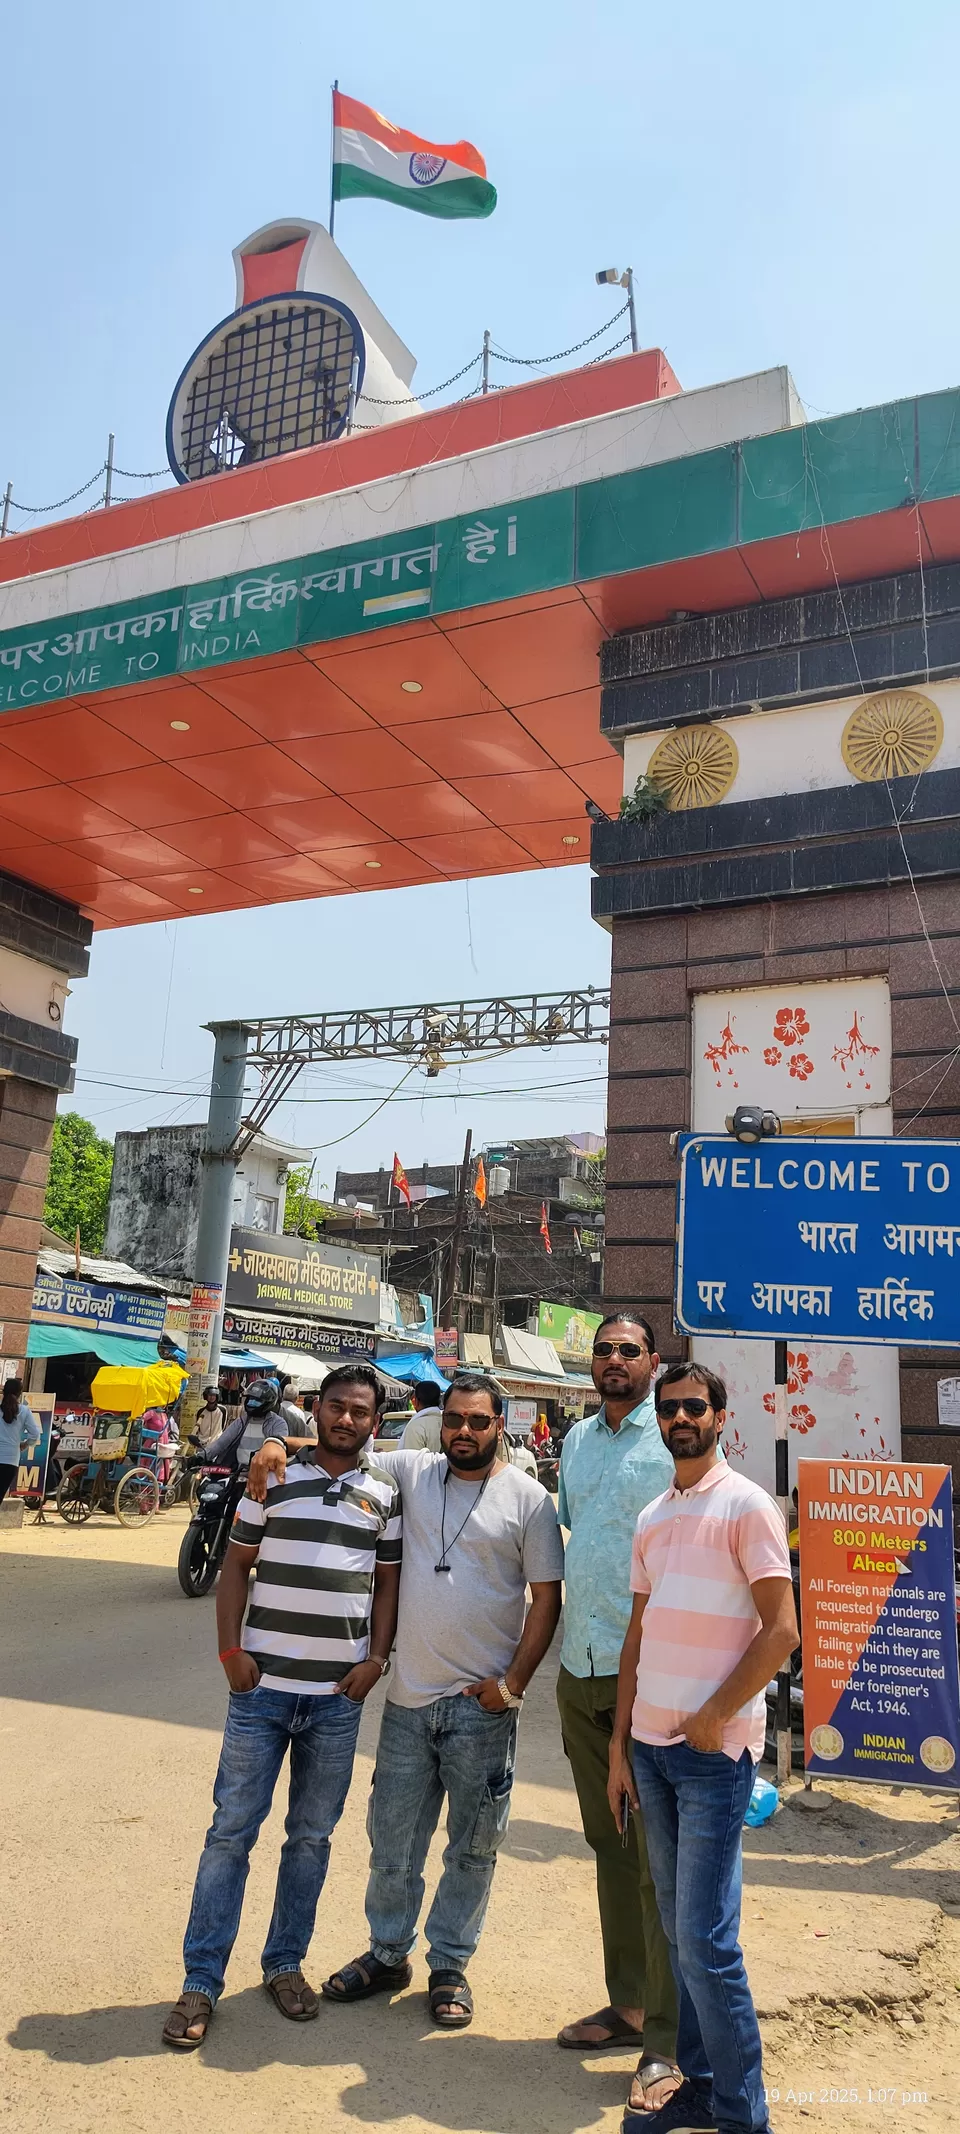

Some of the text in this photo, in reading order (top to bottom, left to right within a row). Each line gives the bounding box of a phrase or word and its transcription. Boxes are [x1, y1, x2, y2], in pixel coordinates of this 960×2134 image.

[50, 606, 183, 656] आपका
[187, 572, 298, 630] हार्दिक
[300, 543, 441, 600] स्वागत
[0, 629, 260, 702] LCOME TO INDIA
[701, 1157, 949, 1193] WELCOME TO
[798, 1220, 960, 1257] भारत आगम
[244, 1249, 300, 1285] जायसवाल
[66, 1290, 116, 1319] एजेन्सी
[257, 1283, 292, 1301] JAISWAL
[294, 1288, 328, 1306] MEDICAL
[329, 1295, 353, 1310] STORE
[697, 1276, 934, 1321] पर आपका हार्दिक
[235, 1318, 296, 1339] जायसवाल
[241, 1334, 278, 1345] JAISWAL
[280, 1339, 315, 1350] MEDICAL
[316, 1345, 340, 1353] STORE
[829, 1467, 923, 1498] INDIAN
[808, 1501, 943, 1528] IMMIGRATION
[833, 1529, 927, 1552] 800 Meters
[853, 1554, 900, 1574] Ahea
[809, 1579, 946, 1601] All Foreign nationals are
[816, 1601, 939, 1623] requested to undergo
[816, 1616, 942, 1640] immigration clearance
[818, 1636, 940, 1660] failing which they are
[814, 1655, 945, 1679] liable to be prosecuted
[831, 1677, 929, 1699] under foreigner's
[850, 1697, 911, 1716] Act, 1946.
[863, 1733, 906, 1750] INDIAN
[853, 1748, 914, 1764] IMMIGRATION
